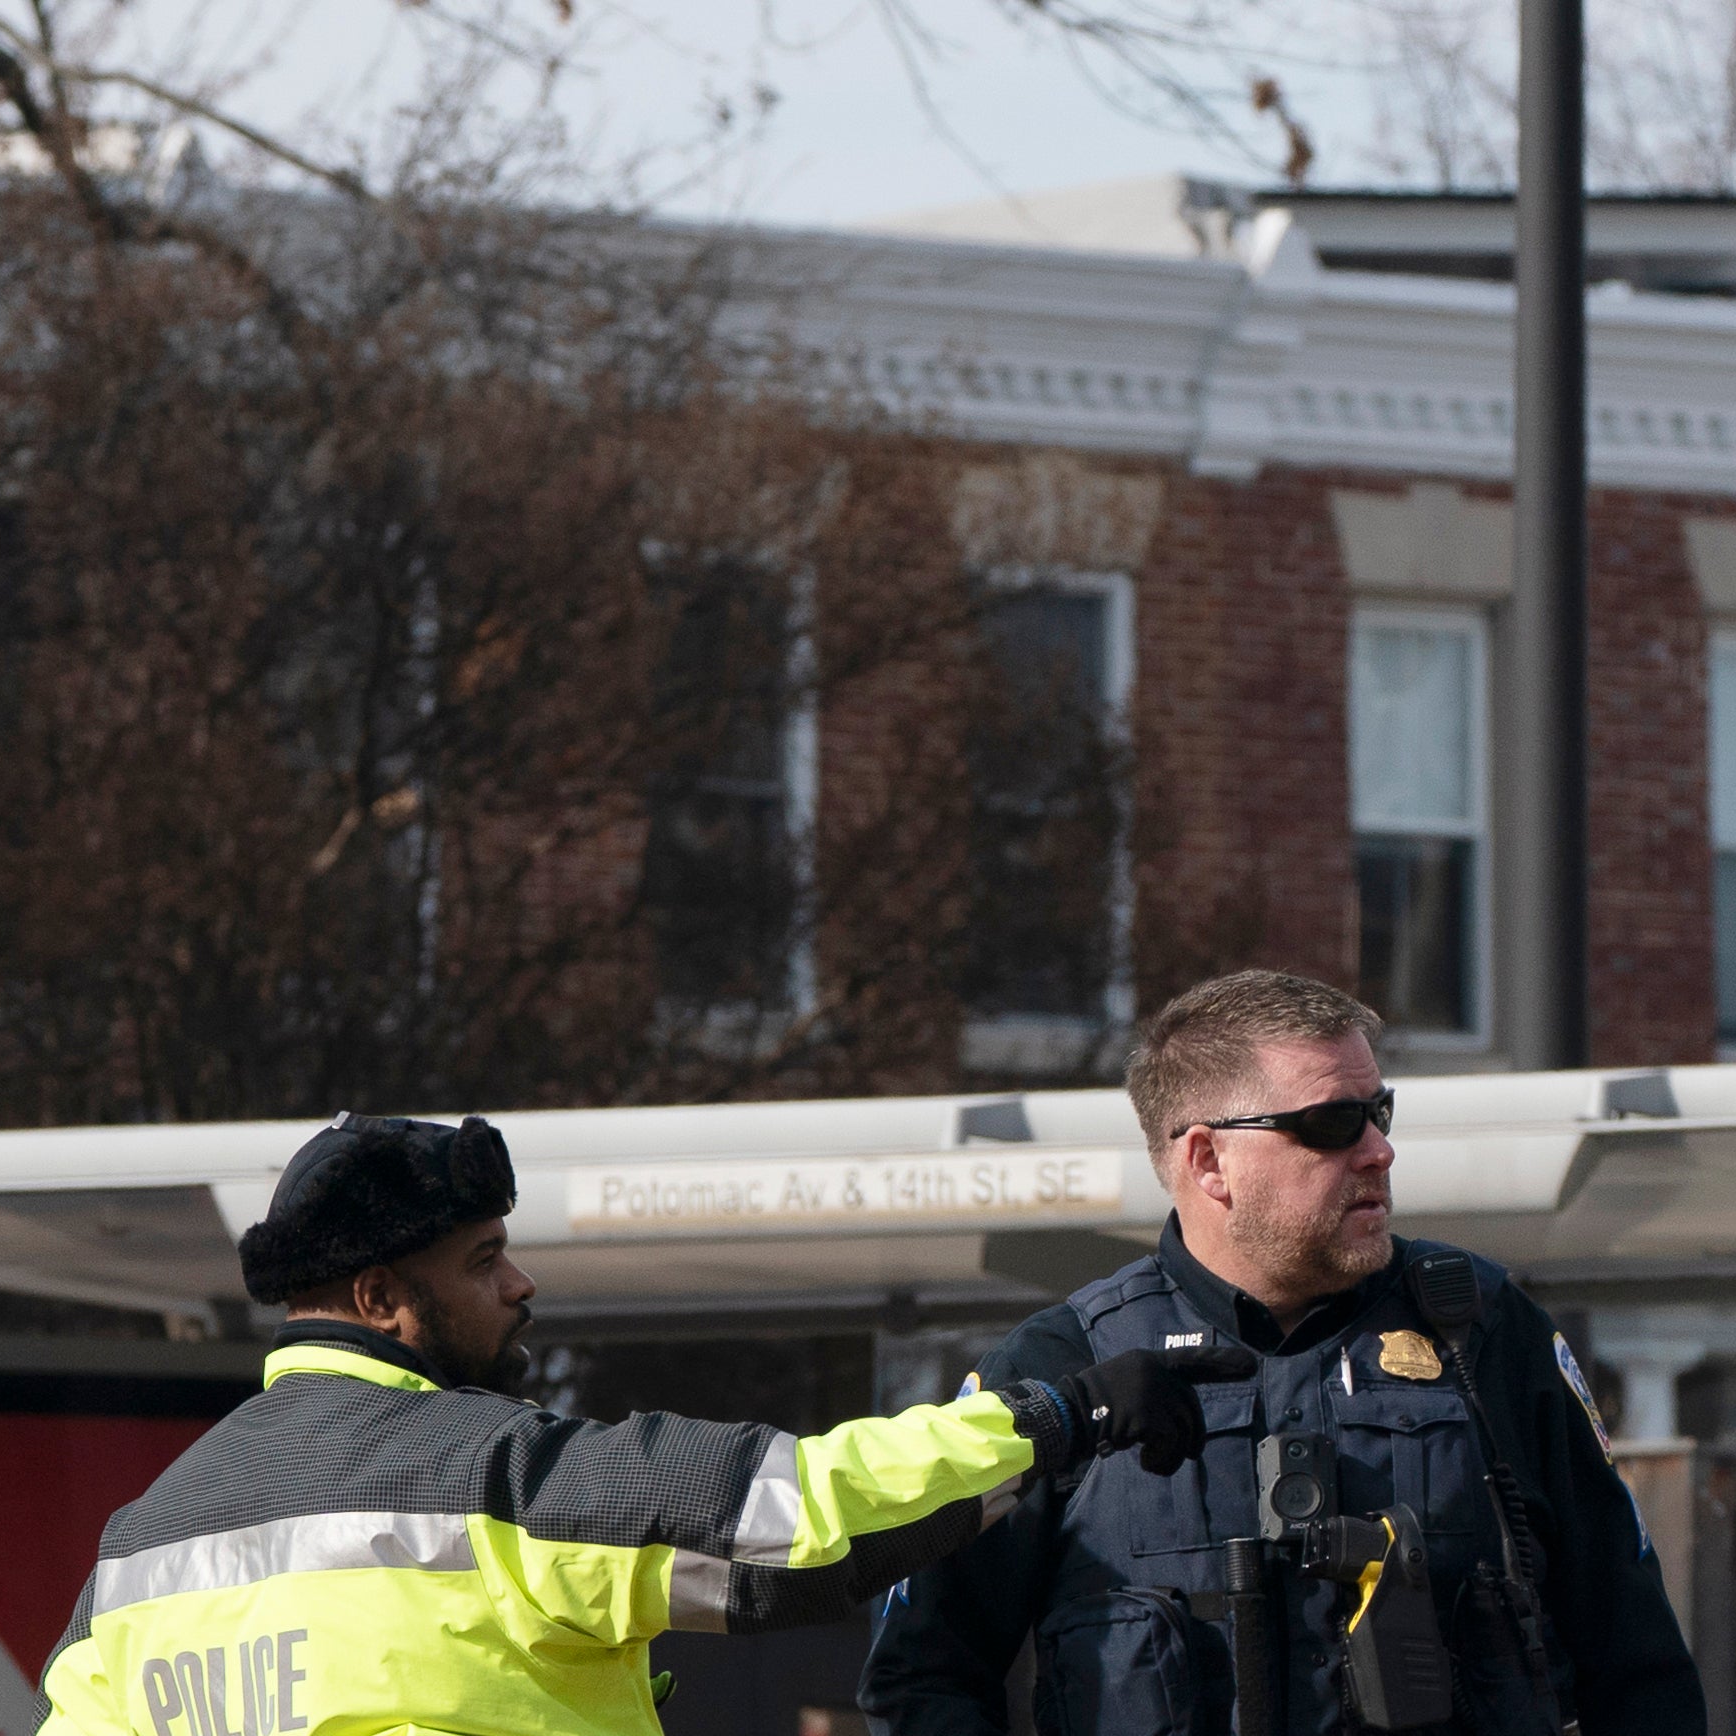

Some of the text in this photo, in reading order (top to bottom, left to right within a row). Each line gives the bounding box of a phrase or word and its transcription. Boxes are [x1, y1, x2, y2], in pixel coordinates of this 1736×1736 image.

[599, 1175, 765, 1217] Potomac
[778, 1169, 827, 1211] Av
[842, 1166, 864, 1208] &
[882, 1165, 957, 1207] 14th
[1035, 1161, 1088, 1203] SE
